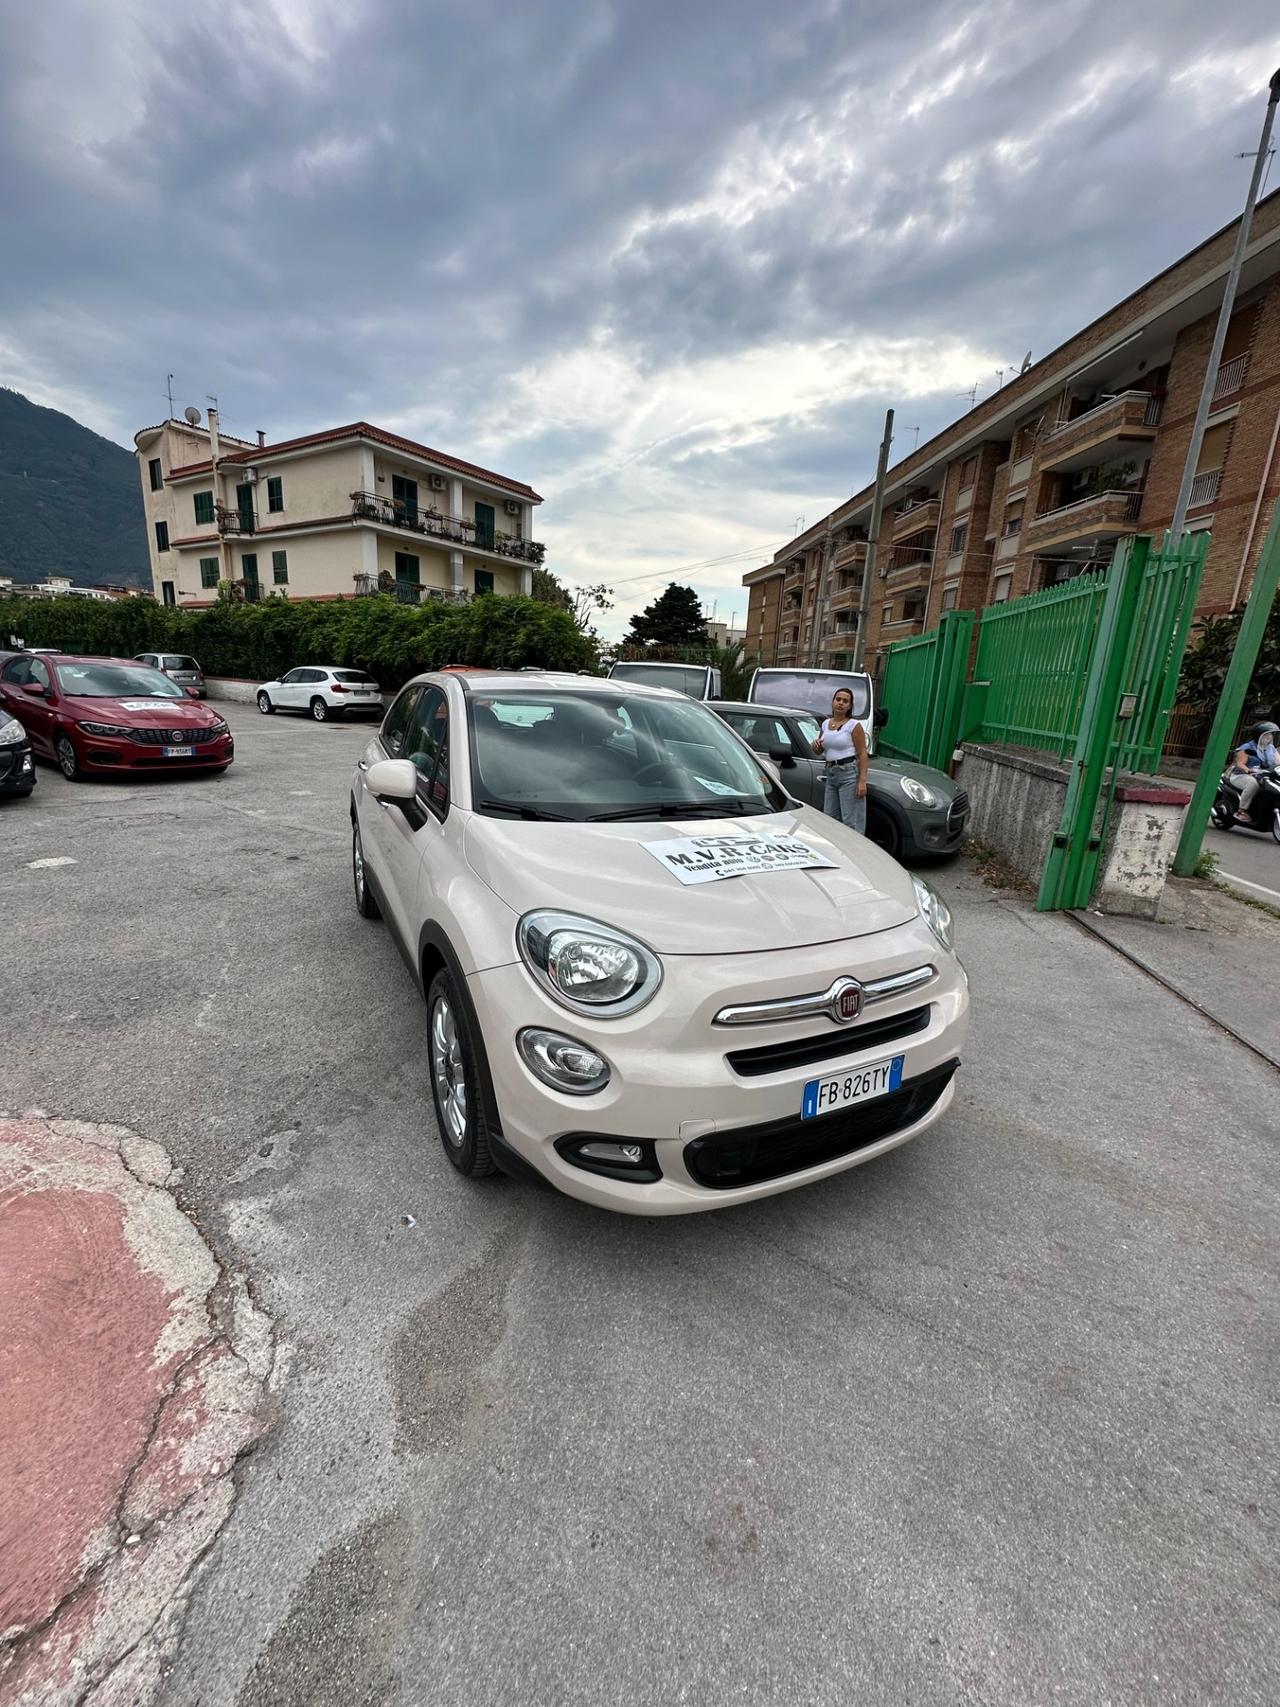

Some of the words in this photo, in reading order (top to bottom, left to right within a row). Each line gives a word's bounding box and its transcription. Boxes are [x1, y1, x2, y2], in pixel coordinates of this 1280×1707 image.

[665, 844, 810, 866] M.V.R.CARS
[683, 860, 722, 872] Vendita
[722, 858, 744, 866] auto
[842, 994, 860, 1013] FIAT
[818, 1081, 839, 1108] FB
[843, 1065, 890, 1100] 826TY
